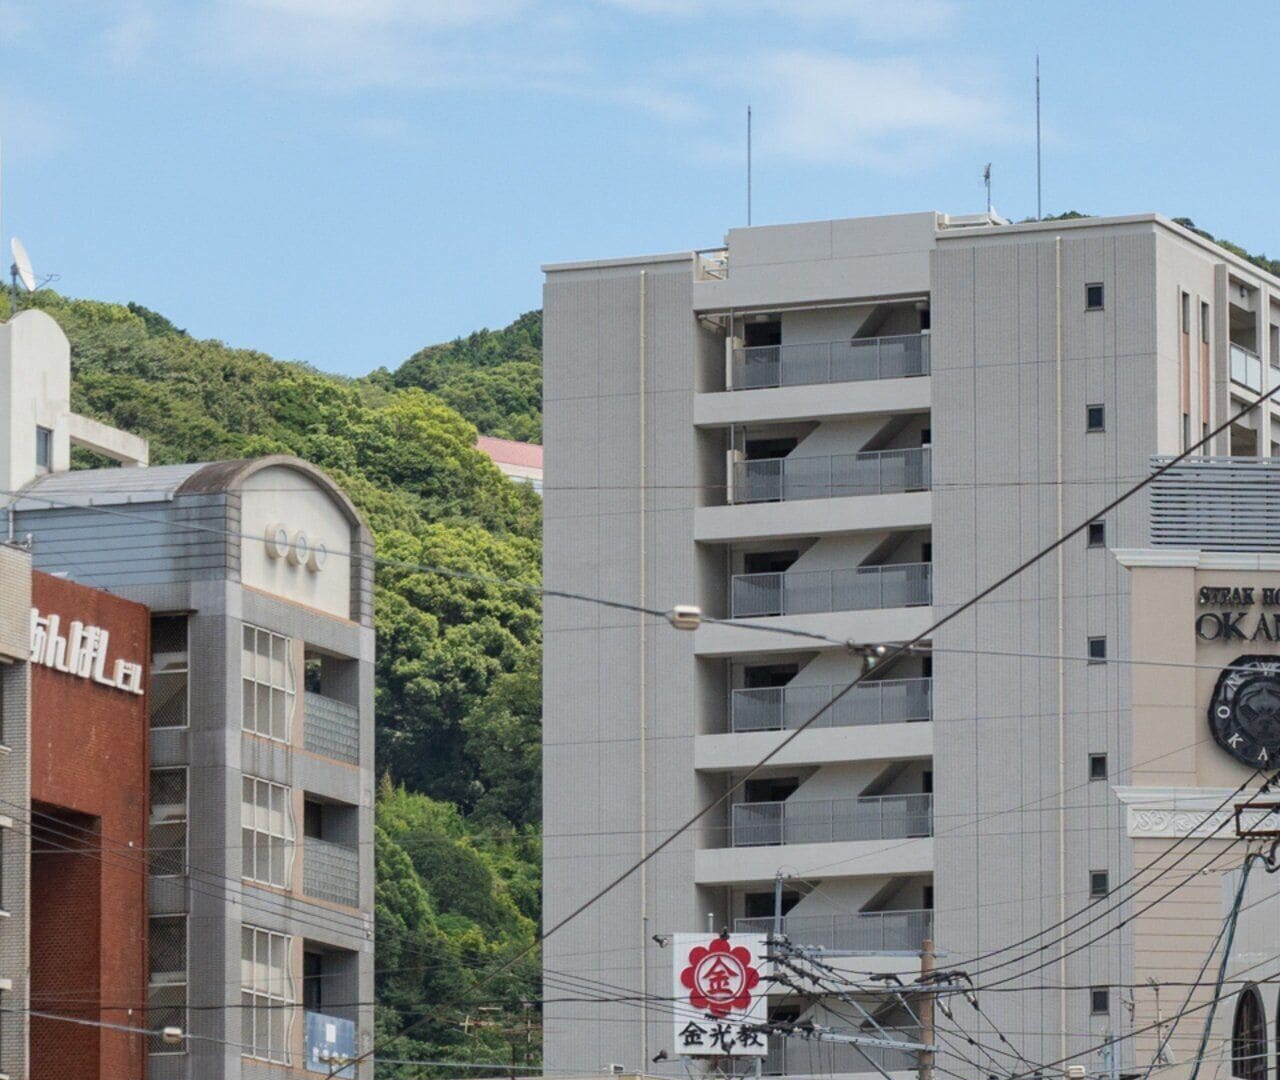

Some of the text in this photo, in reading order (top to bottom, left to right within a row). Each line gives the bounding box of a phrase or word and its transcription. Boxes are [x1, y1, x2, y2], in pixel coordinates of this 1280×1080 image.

[1199, 586, 1255, 606] STEAK
[702, 956, 738, 999] 金
[678, 1019, 765, 1048] 金光教
